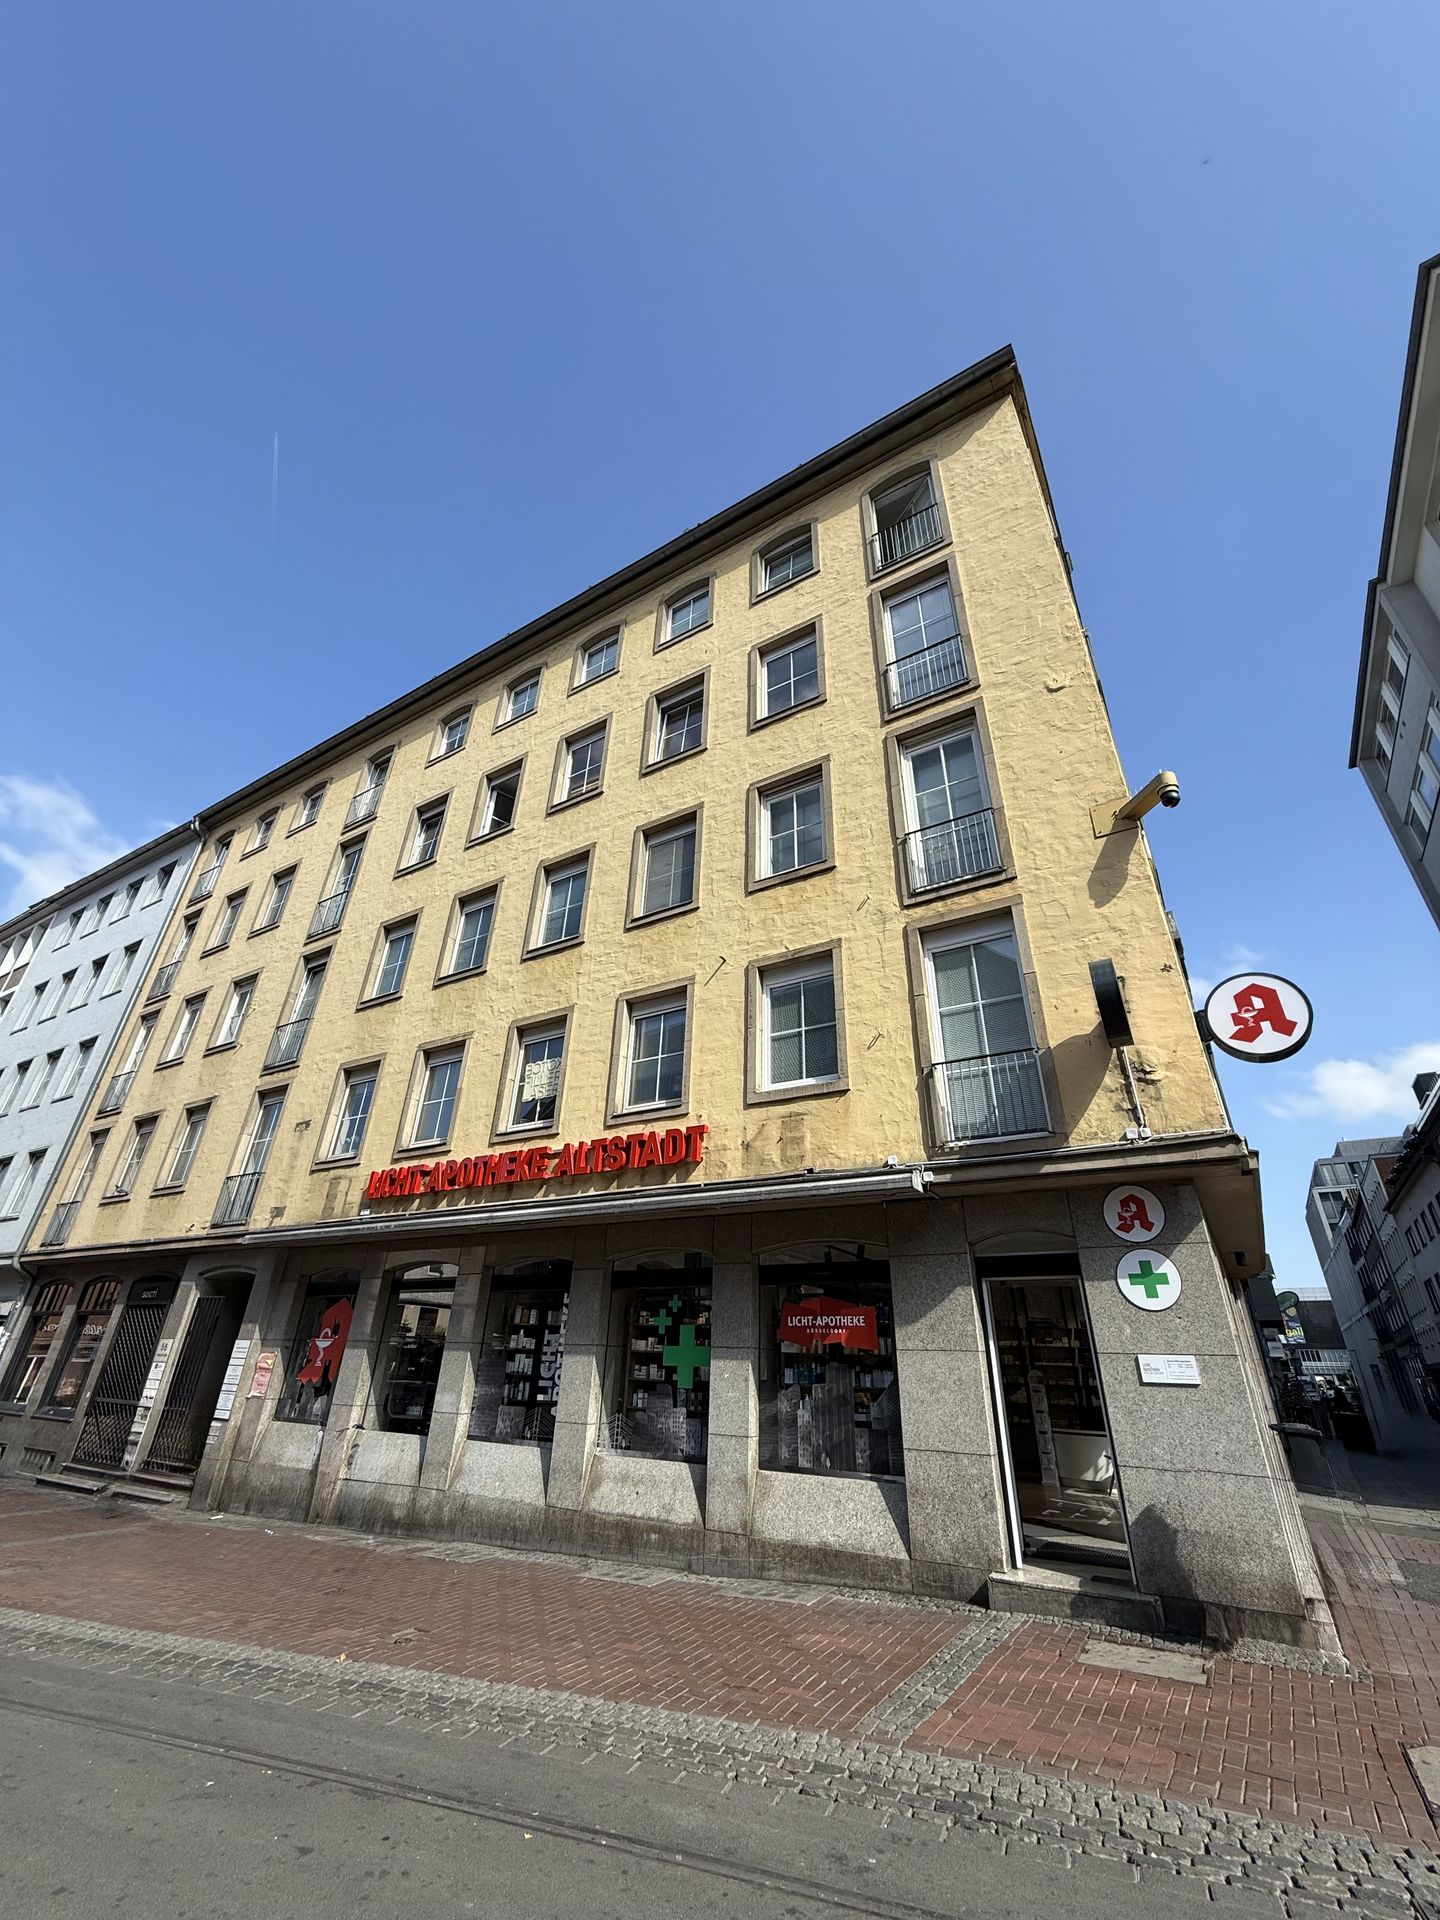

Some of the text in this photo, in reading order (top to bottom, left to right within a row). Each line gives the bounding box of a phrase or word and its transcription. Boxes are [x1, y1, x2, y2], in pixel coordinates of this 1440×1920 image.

[366, 1124, 709, 1200] LICHT APOTHEKE ALTSTADT
[787, 1315, 866, 1327] LICHT-APOTHEKE
[537, 1329, 560, 1401] LICHT
